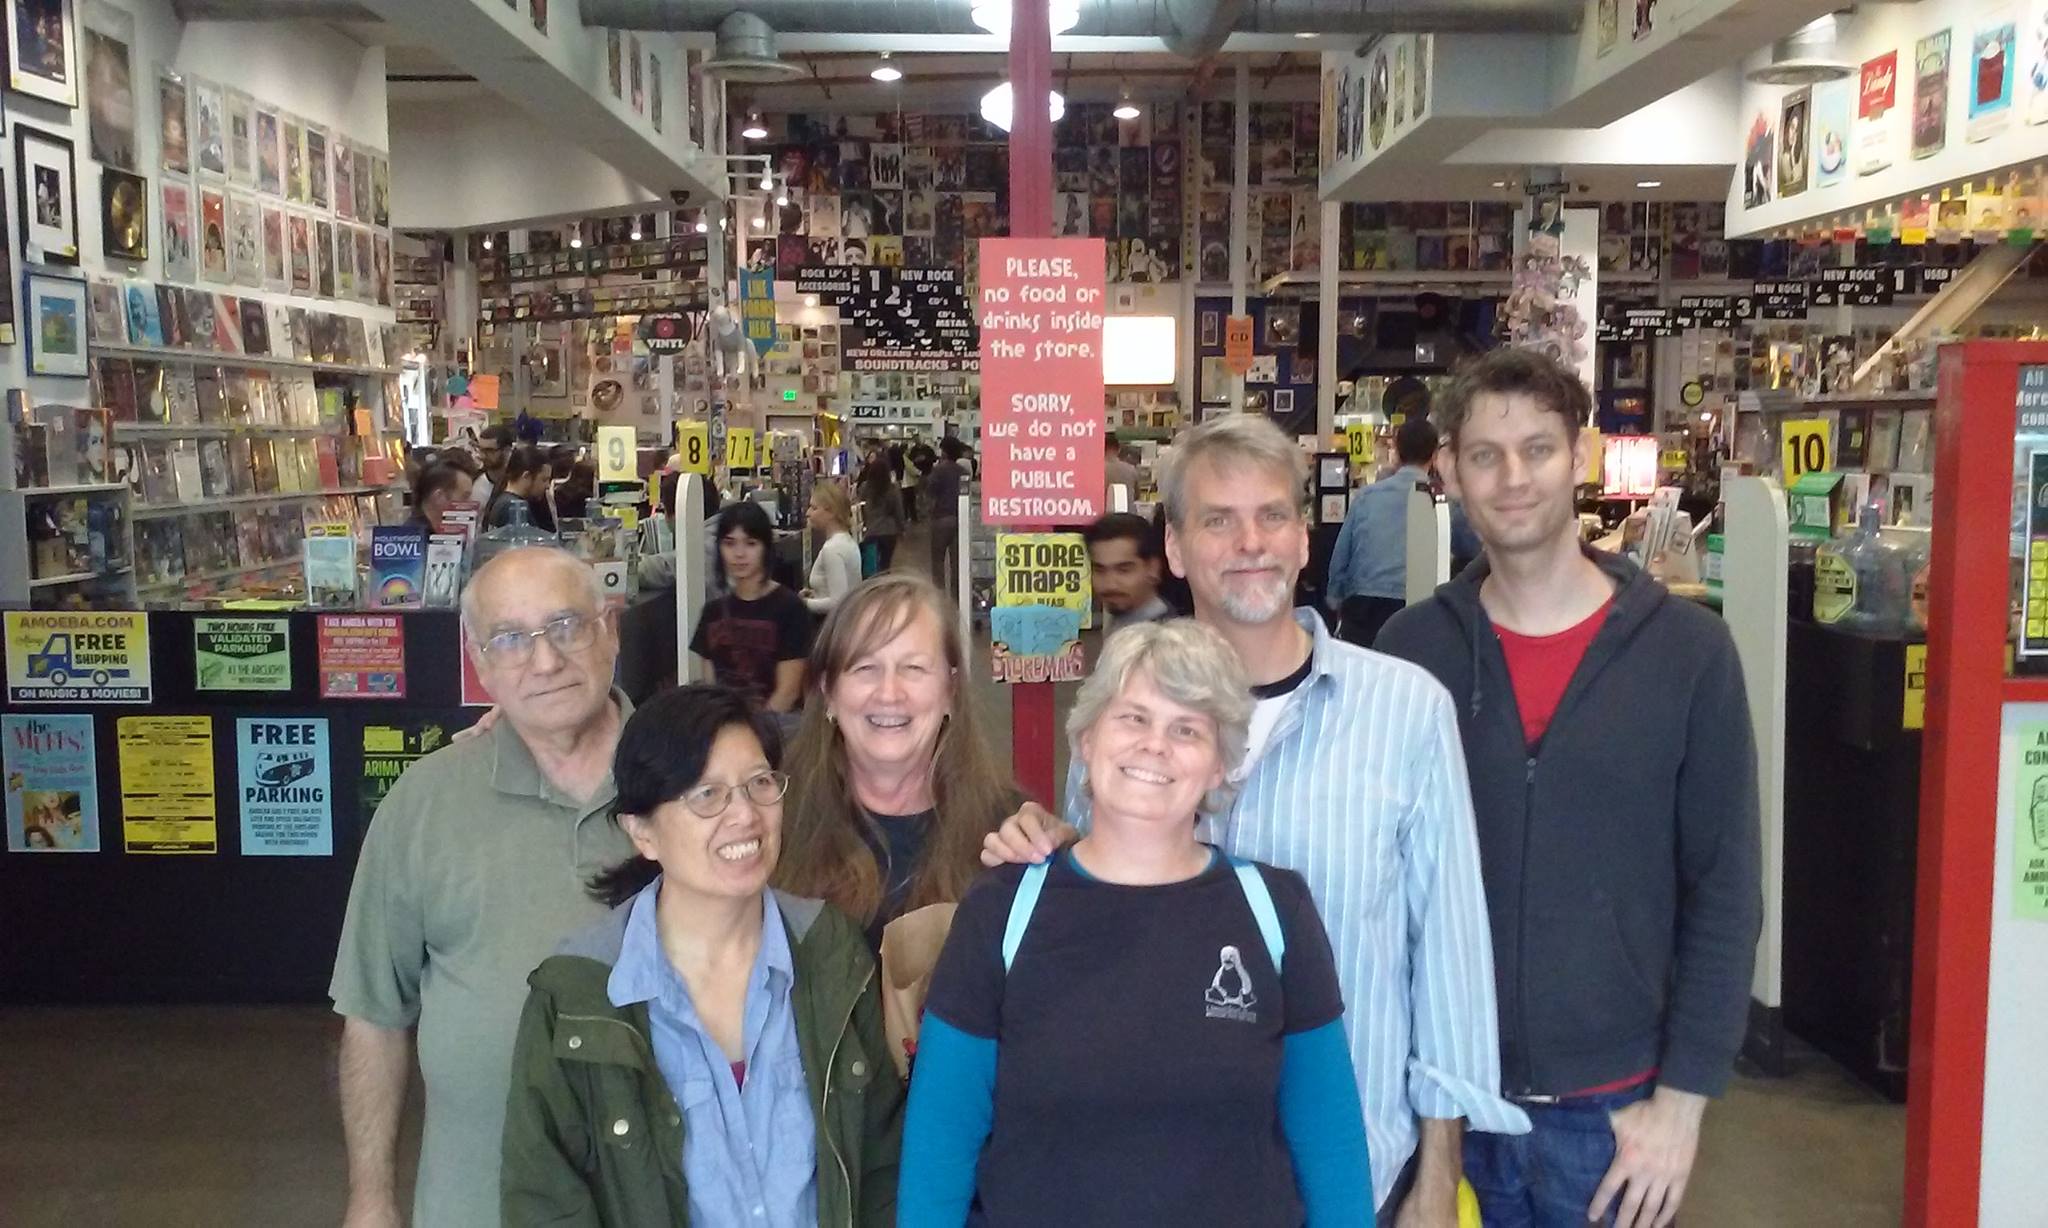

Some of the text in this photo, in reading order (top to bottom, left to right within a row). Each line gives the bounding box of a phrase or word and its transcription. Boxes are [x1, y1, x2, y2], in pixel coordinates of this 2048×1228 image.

[801, 268, 826, 278] ROCK
[900, 269, 954, 281] NEW ROCK
[1006, 257, 1079, 280] PLEASE,
[1823, 269, 1876, 281] NEW ROCK
[869, 269, 880, 291] 1
[916, 283, 939, 293] CD's
[1754, 283, 1802, 294] NEW ROCK
[1893, 269, 1904, 291] 1
[984, 284, 1100, 303] no food or
[1736, 298, 1751, 317] 3
[935, 318, 969, 328] METAL
[982, 310, 1102, 333] drinks inside
[646, 338, 686, 349] VINYL
[990, 339, 1095, 362] the store.
[855, 358, 950, 370] SOUNDTRACKS
[1010, 393, 1075, 416] SORRY,
[988, 418, 1097, 437] we do not
[688, 436, 701, 465] 8
[1010, 443, 1076, 461] have a
[1349, 431, 1363, 456] 13
[608, 436, 626, 472] 9
[1788, 432, 1826, 476] 10
[1010, 470, 1075, 489] PUBLIC
[988, 497, 1097, 517] RESTROOM.
[374, 543, 422, 557] BOWL
[1005, 543, 1084, 568] STORE
[20, 616, 134, 629] AMOEBA.COM
[74, 633, 126, 650] FREE
[209, 633, 273, 643] VALIDATED
[75, 653, 129, 665] SHIPPING
[19, 688, 143, 699] ON MUSIC & MOVIES!
[250, 723, 316, 745] FREE
[364, 759, 401, 777] ARIMA
[245, 787, 324, 803] PARKING
